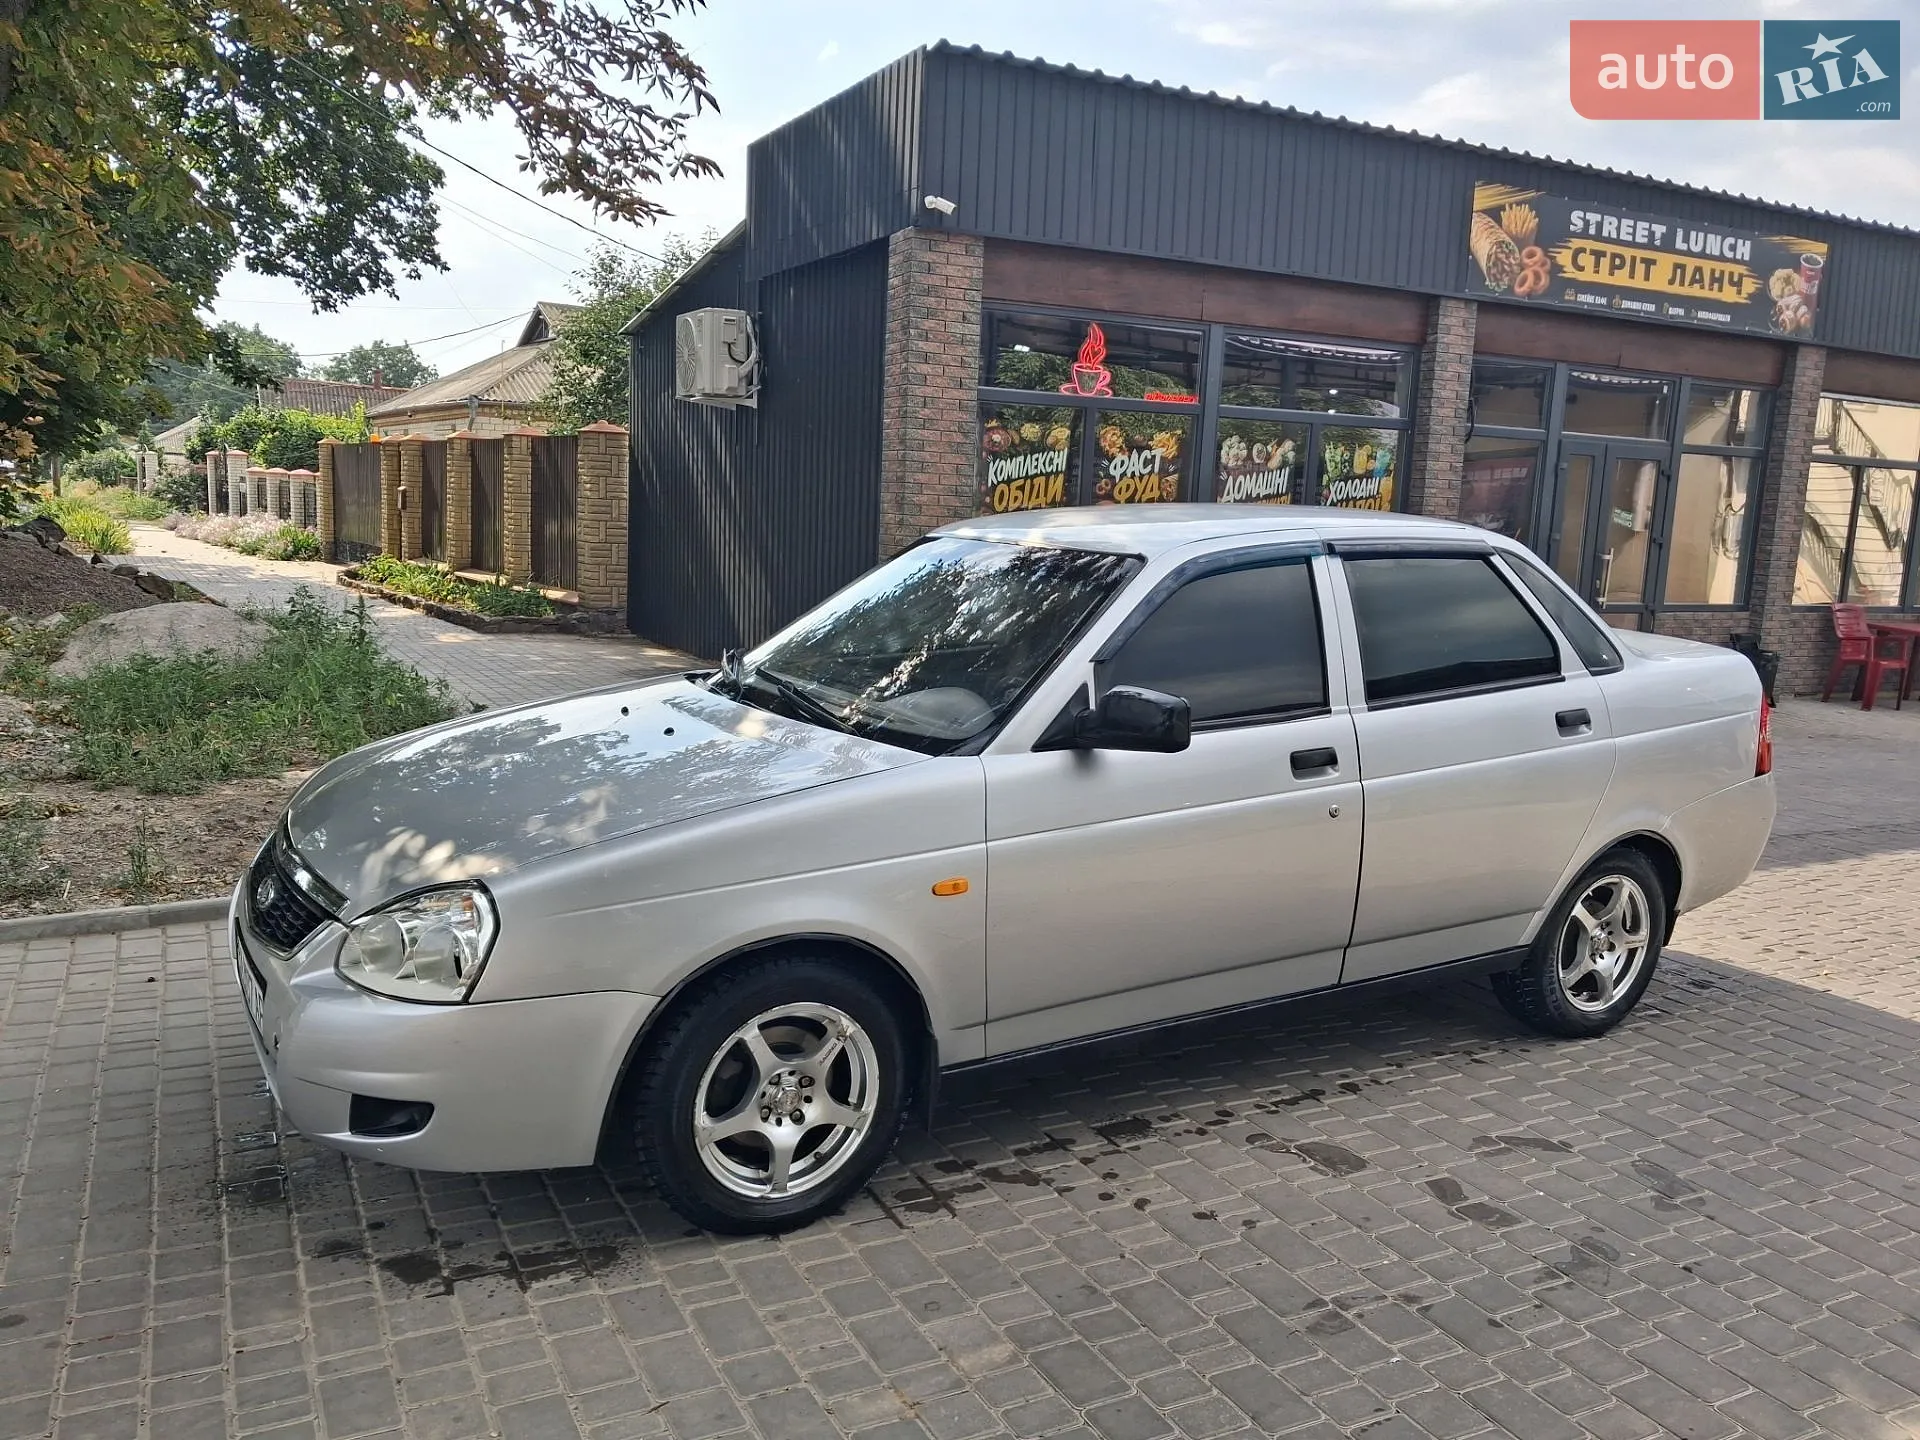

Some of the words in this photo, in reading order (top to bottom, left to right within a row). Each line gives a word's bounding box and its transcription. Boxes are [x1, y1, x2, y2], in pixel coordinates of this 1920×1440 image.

[1569, 210, 1667, 246] STREET
[1674, 228, 1752, 261] LUNCH
[1571, 247, 1658, 282] СТРІТ
[1667, 262, 1745, 296] ЛАНЧ
[988, 447, 1068, 487] КОМПЛЕКСНІ
[1109, 448, 1166, 483] ФАСТ
[993, 474, 1065, 513] ОБІДИ
[1113, 473, 1161, 504] ФУД
[1221, 467, 1289, 503] ДОМАШНІ
[1326, 476, 1380, 506] ХОЛОДНІ
